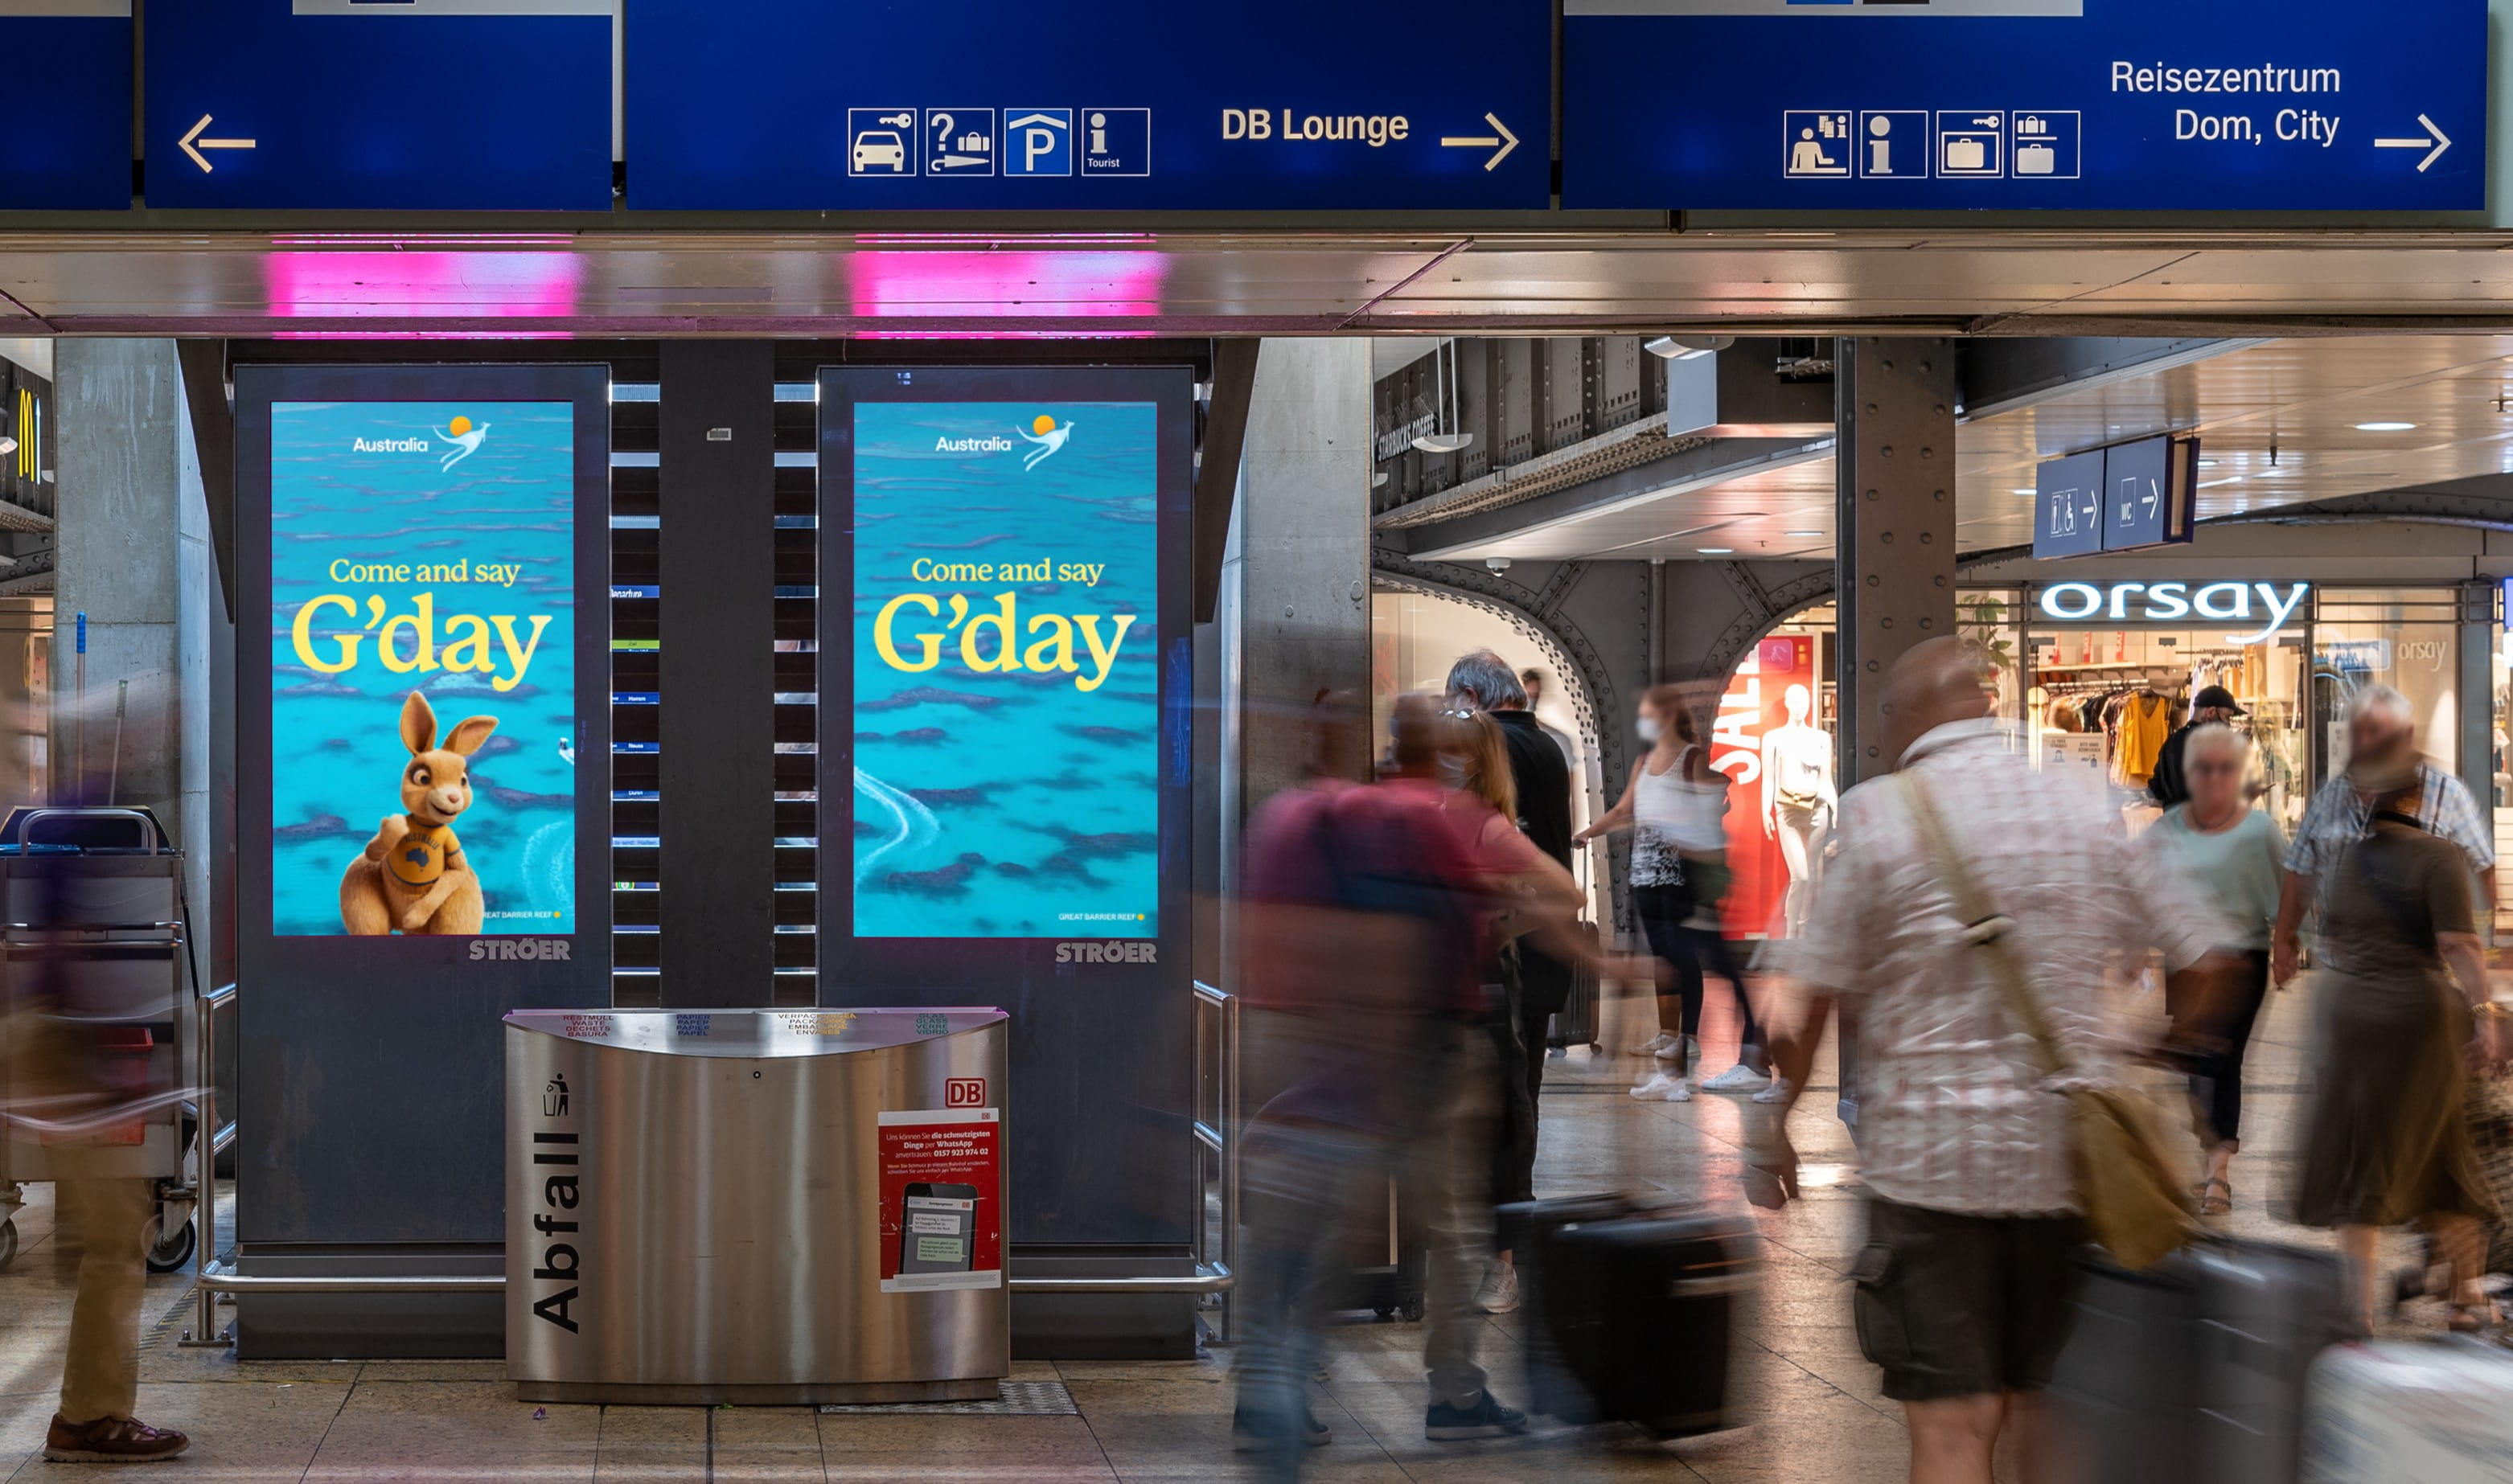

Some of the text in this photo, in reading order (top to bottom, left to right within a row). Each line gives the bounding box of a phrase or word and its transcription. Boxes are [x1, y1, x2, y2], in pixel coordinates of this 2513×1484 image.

[2112, 61, 2340, 92] Reisezentrum
[1222, 109, 1409, 147] DB Lounge
[2176, 109, 2340, 147] Dom, City
[1087, 158, 1120, 167] Tourist
[353, 437, 428, 453] Australia
[935, 437, 1012, 452] Australia
[1378, 423, 1411, 462] STARBUCKS
[2121, 502, 2132, 521] WC
[330, 559, 521, 588] Come and say
[912, 558, 1105, 587] Come and say
[2040, 582, 2310, 644] orsay
[292, 592, 552, 692] G'day
[874, 592, 1135, 692] G'day
[2398, 641, 2446, 672] orsay
[403, 832, 440, 851] USTRALIA
[482, 911, 552, 919] REAT BARRIER REEF
[469, 937, 571, 961] STRÖER
[1055, 941, 1157, 963] STRÖER
[951, 1083, 980, 1104] DB
[899, 1132, 922, 1140] können
[922, 1131, 930, 1139] Sie
[943, 1130, 991, 1139] schmutzigsten
[904, 1140, 973, 1150] Dinge per WhatsApp
[895, 1150, 932, 1158] anvertrauen:
[934, 1150, 950, 1158] 0157
[965, 1148, 979, 1156] 974
[533, 1133, 580, 1334] Abfall
